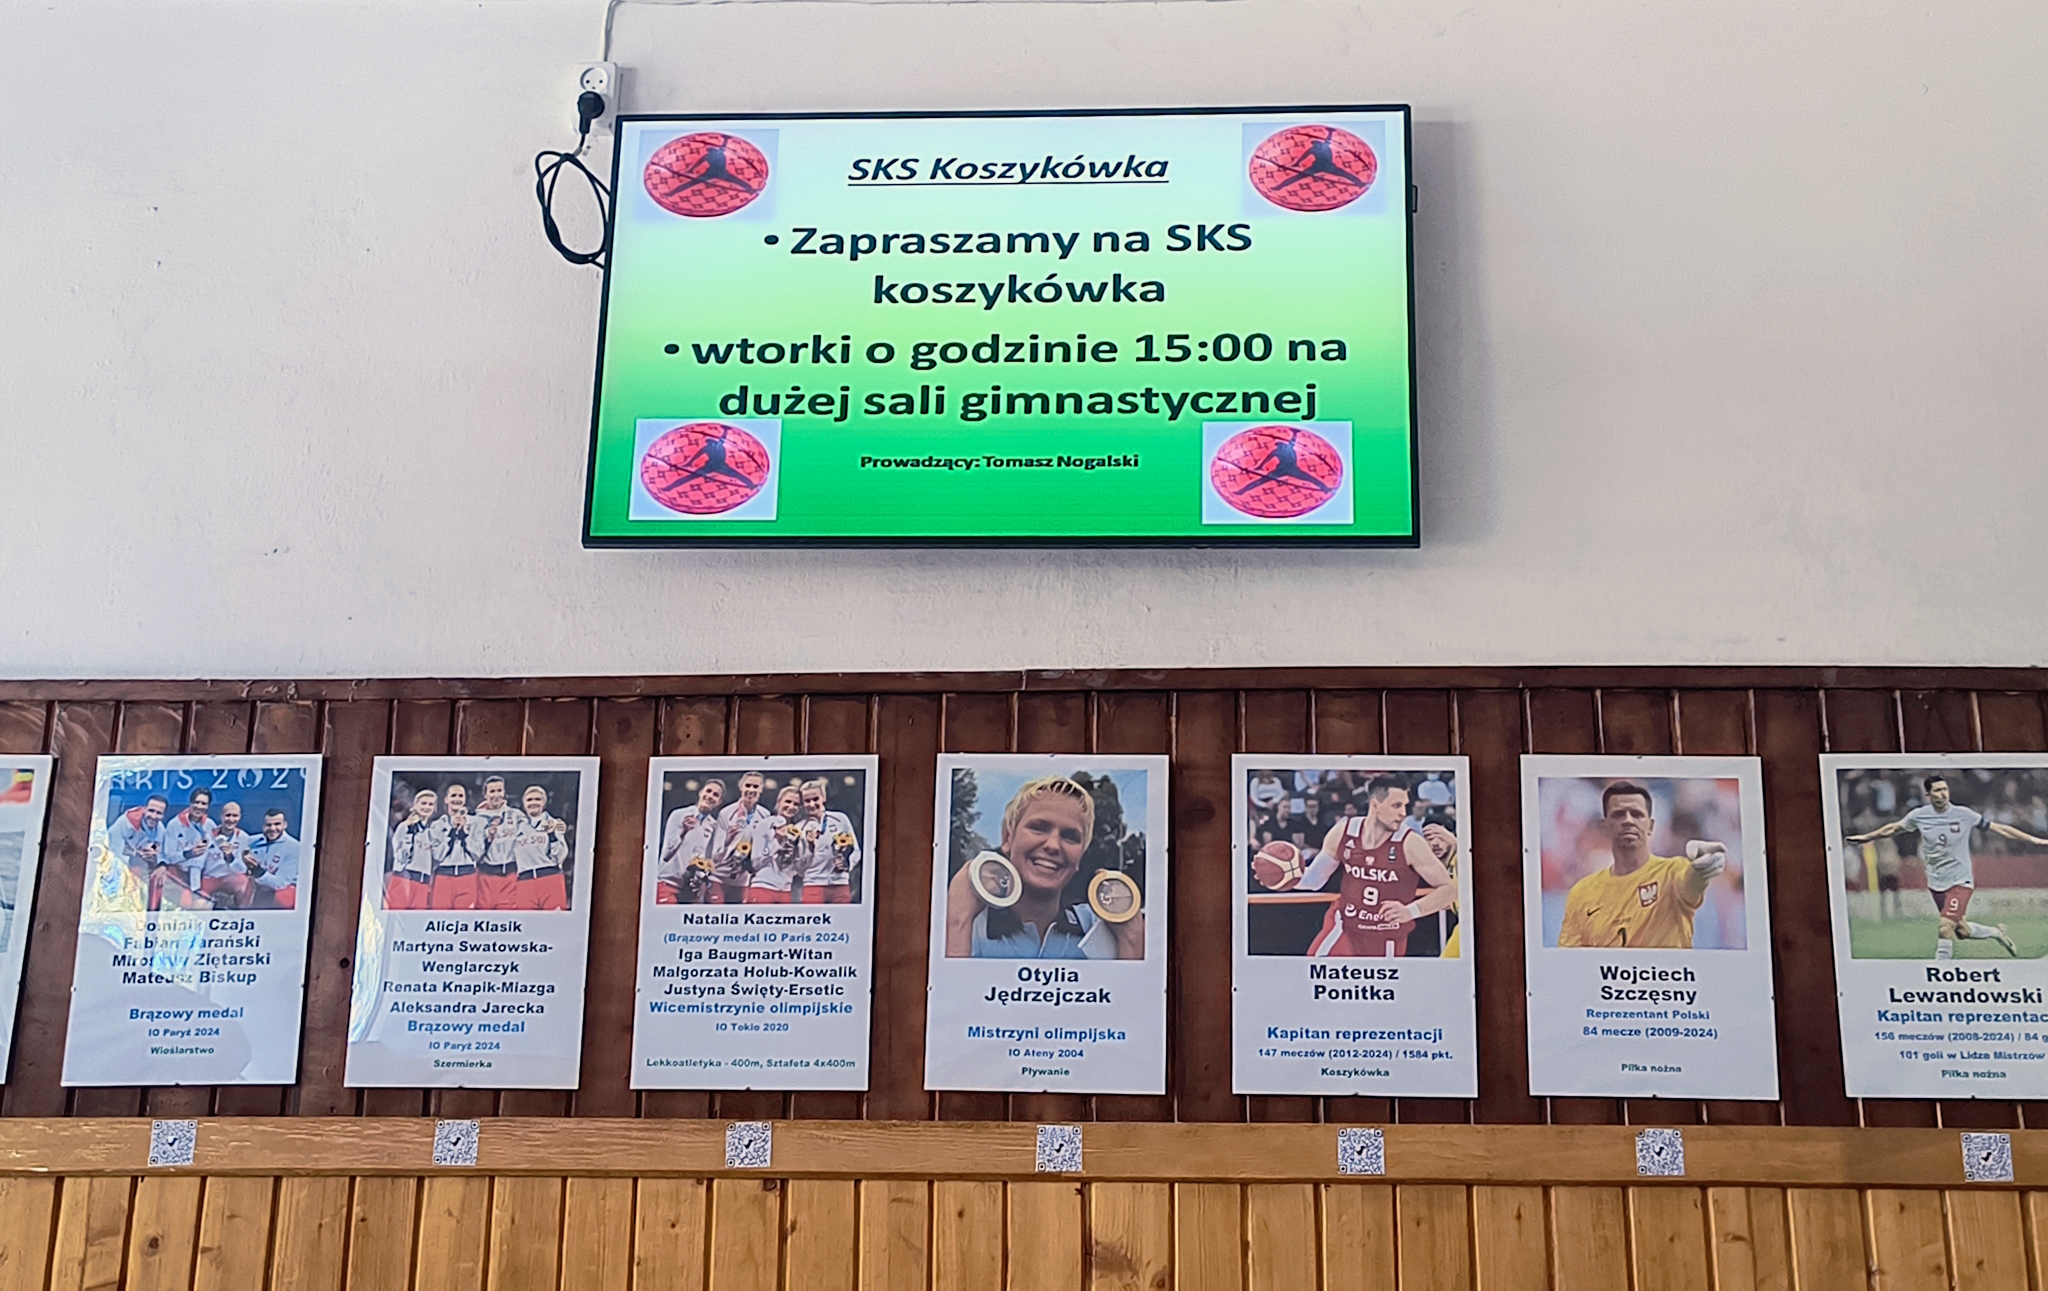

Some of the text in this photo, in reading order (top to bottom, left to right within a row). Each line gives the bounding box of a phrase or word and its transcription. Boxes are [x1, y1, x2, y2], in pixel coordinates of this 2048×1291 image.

[848, 154, 1168, 183] SKS Koszykówka
[790, 223, 1253, 261] Zapraszamy na SKS
[873, 274, 1165, 311] koszykówka
[691, 333, 1346, 370] wtorki o godzinie 15:00 na
[718, 383, 1317, 423] dużej sali gimnastycznej
[860, 454, 1139, 470] Prowadzący: Tomasz Nogalski
[1344, 864, 1398, 882] POLSKA
[1363, 887, 1379, 906] 9
[209, 918, 255, 933] Czaja
[683, 913, 831, 925] Natalia Kaczmarek
[425, 921, 522, 934] Alicja Klasik
[664, 933, 720, 944] (Brązowy
[723, 933, 760, 942] medal
[781, 933, 811, 942] Paris
[816, 933, 849, 943] 2024)
[393, 941, 553, 954] Martyna Swatowska-
[194, 953, 270, 968] Ziętarski
[679, 949, 832, 962] Iga Baugmart-Witan
[422, 961, 520, 975] Wenglarczyk
[744, 966, 857, 978] Holub-Kowalik
[1310, 965, 1399, 980] Mateusz
[1599, 966, 1696, 984] Wojciech
[1926, 967, 2001, 983] Robert
[122, 971, 257, 985] Mateusz Biskup
[1018, 967, 1079, 985] Otylia
[383, 981, 555, 996] Renata Knapik-Miazga
[664, 981, 844, 998] Justyna Święty-Ersetic
[1314, 985, 1395, 1000] Ponitka
[1600, 986, 1697, 1005] Szczęsny
[984, 987, 1111, 1006] Jędrzejczak
[1889, 988, 2043, 1004] Lewandowski
[129, 1007, 244, 1021] Brązowy medal
[390, 1002, 545, 1014] Aleksandra Jarecka
[649, 1002, 853, 1016] Wicemistrzynie olimpijskie
[1586, 1009, 1710, 1020] Reprezentant Polski
[1877, 1010, 1943, 1025] Kapitan
[163, 1028, 191, 1038] Paryż
[194, 1028, 220, 1036] 2024
[407, 1020, 525, 1035] Brązowy medal
[731, 1023, 760, 1031] Tokio
[763, 1023, 789, 1031] 2020
[1583, 1027, 1718, 1039] 84 mecze (2009-2024)
[967, 1026, 1126, 1043] Mistrzyni olimpijska
[1267, 1026, 1443, 1043] Kapitan reprezentacji
[1899, 1032, 1944, 1041] meczów
[150, 1046, 214, 1055] Wioślarstwo
[444, 1041, 472, 1051] Paryż
[475, 1042, 500, 1050] 2024
[1024, 1049, 1055, 1059] Ateny
[1258, 1049, 1277, 1057] 147
[1280, 1049, 1325, 1058] meczów
[1328, 1049, 1393, 1060] (2012-2024)
[1402, 1050, 1428, 1059] 1584
[1431, 1050, 1453, 1061] pkt.
[1900, 1051, 1918, 1060] 101
[1923, 1051, 1943, 1061] goli
[1960, 1051, 1990, 1060] Lidze
[1994, 1051, 2046, 1060] Mistrzów
[433, 1060, 492, 1068] Szermierka
[646, 1059, 721, 1069] Lekkoatletyka
[731, 1059, 764, 1069] 400m,
[766, 1059, 810, 1068] Sztafeta
[813, 1059, 856, 1068] 4x400m
[1651, 1064, 1682, 1073] nożna
[1321, 1067, 1389, 1078] Koszykówka
[1973, 1070, 2006, 1079] nożna
